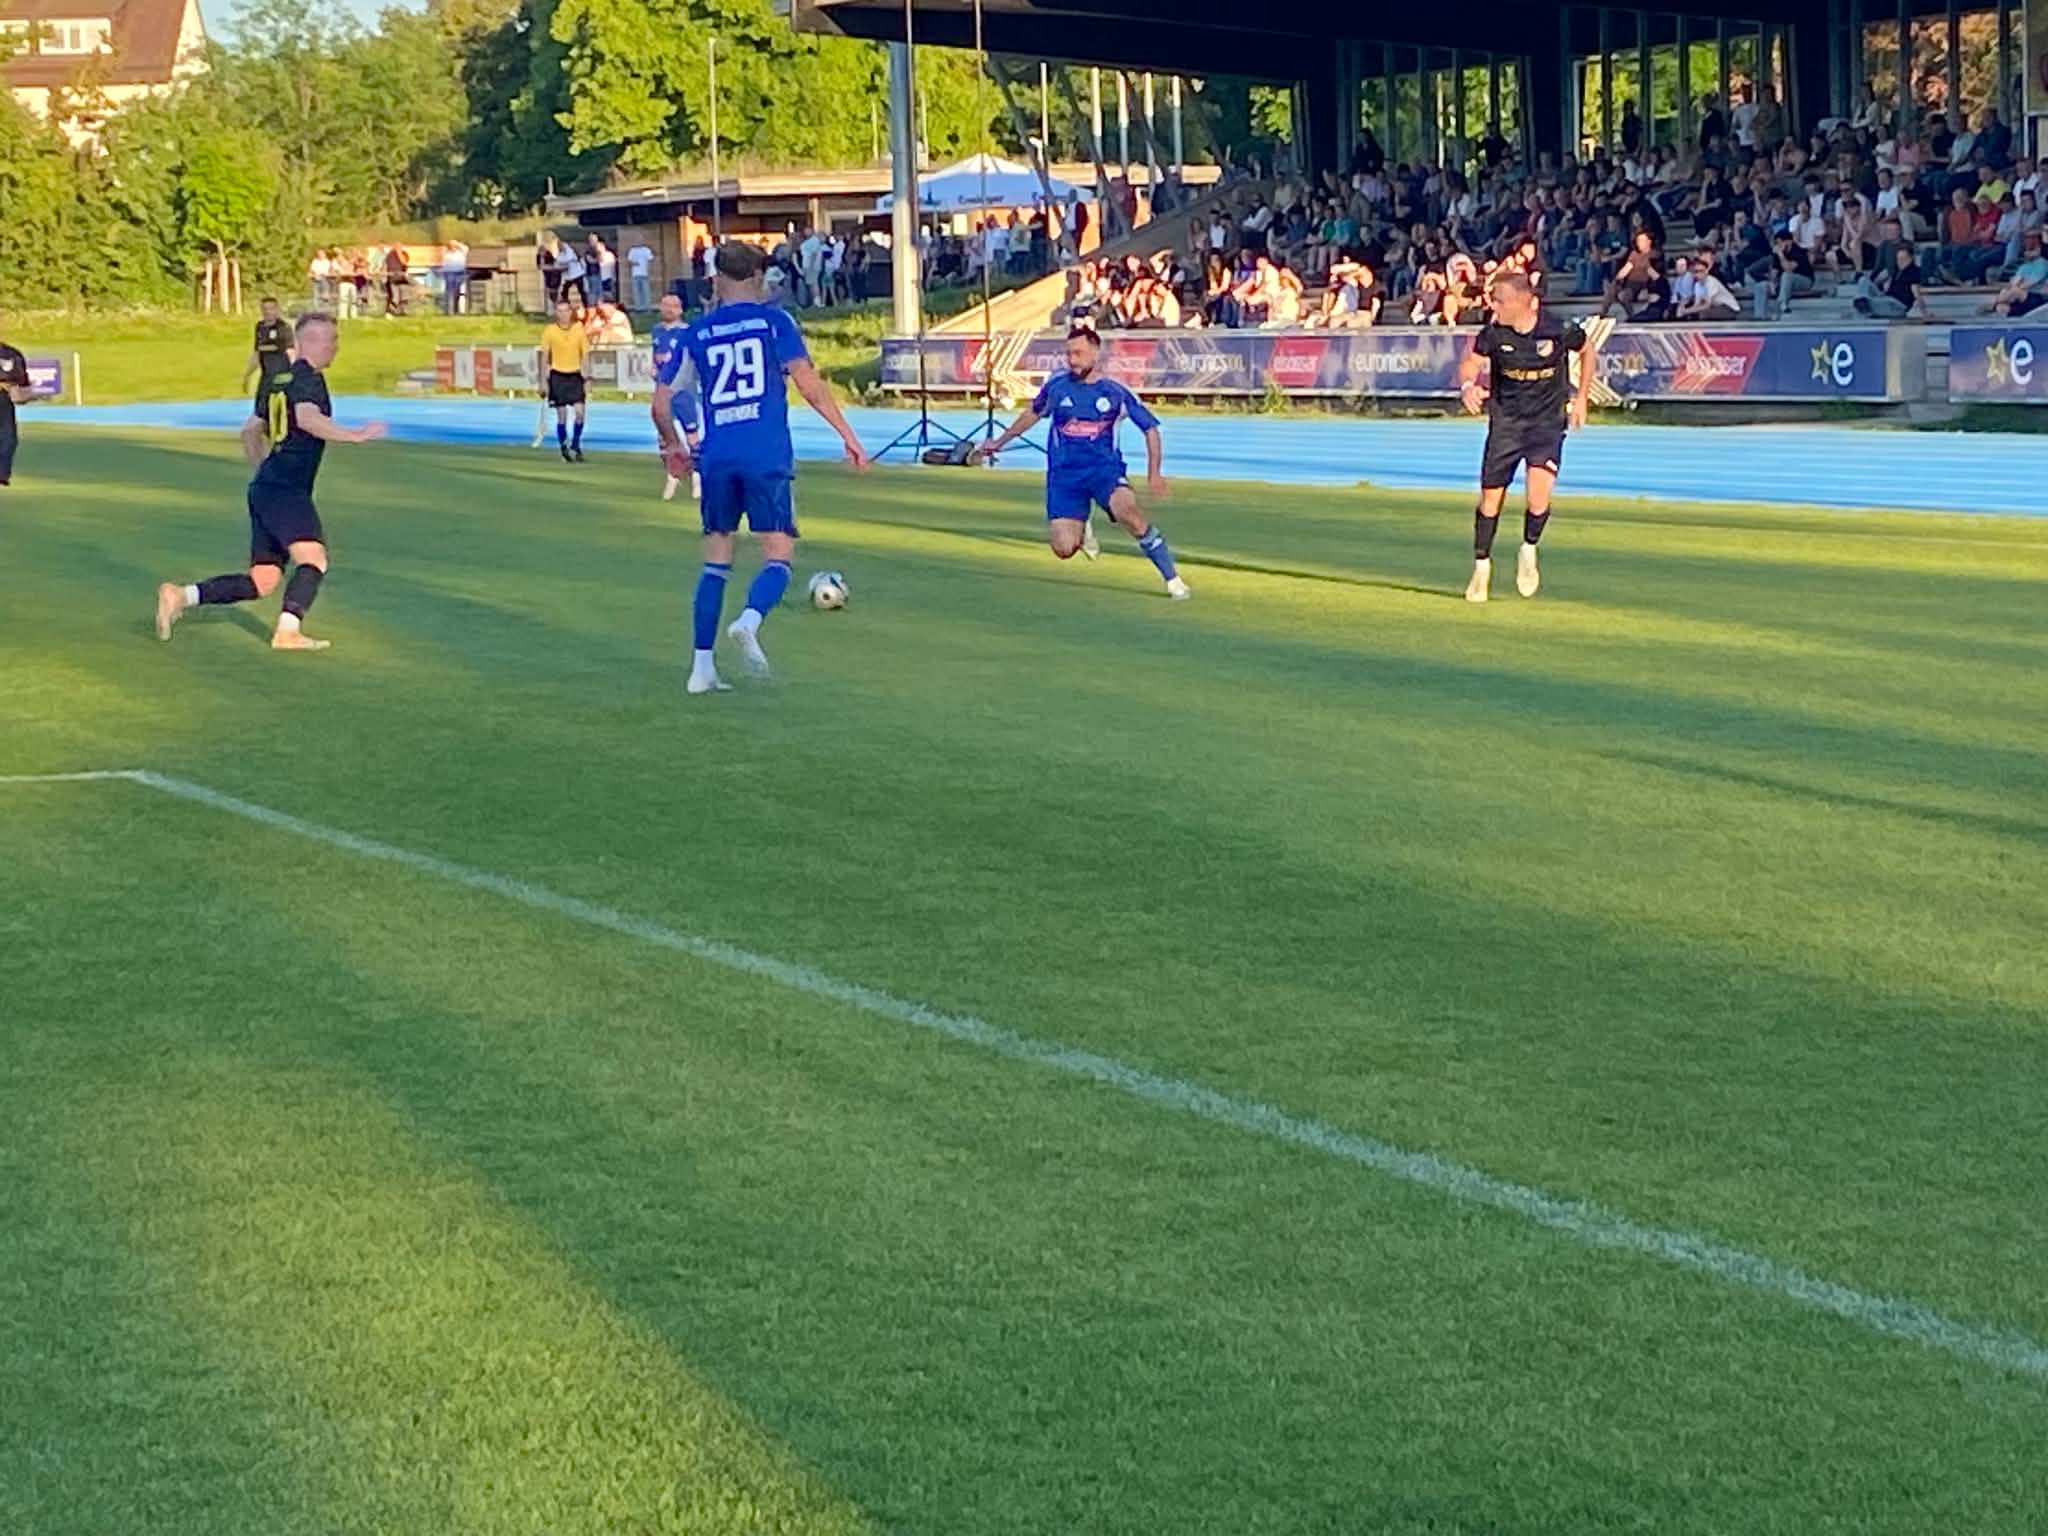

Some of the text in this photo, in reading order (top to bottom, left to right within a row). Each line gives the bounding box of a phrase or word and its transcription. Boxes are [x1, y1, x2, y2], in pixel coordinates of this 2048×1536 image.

[707, 338, 765, 404] 29
[1832, 342, 1854, 386] e
[2010, 339, 2034, 385] e
